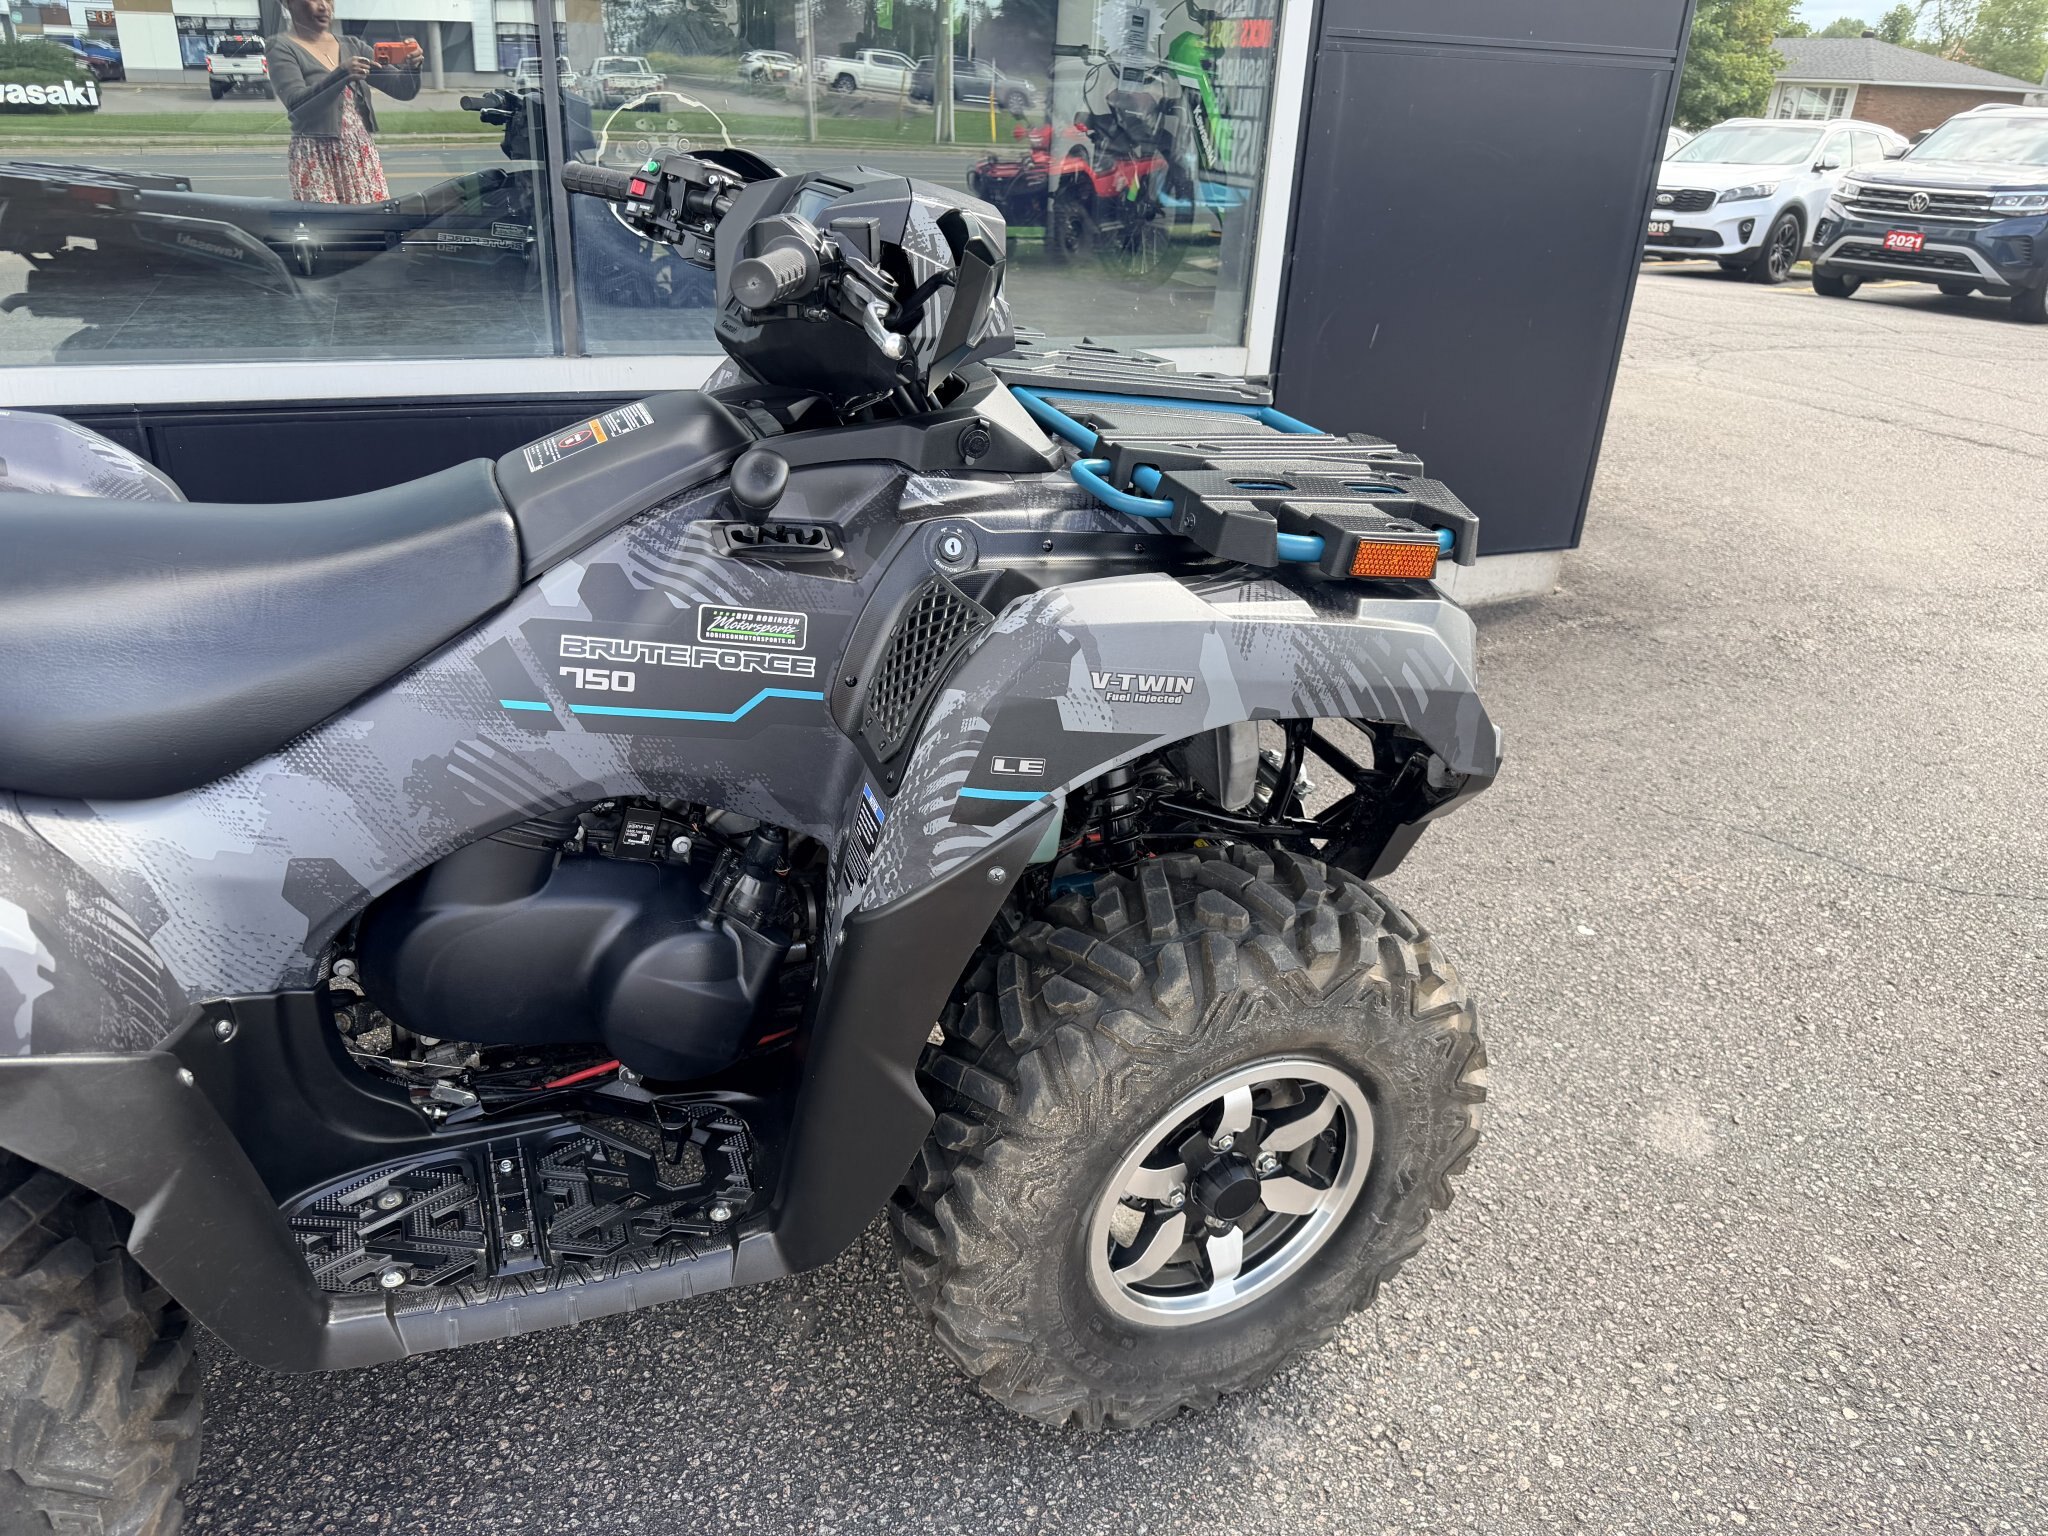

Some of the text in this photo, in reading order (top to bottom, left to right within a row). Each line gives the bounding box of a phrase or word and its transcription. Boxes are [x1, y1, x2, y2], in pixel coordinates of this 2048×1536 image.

[0, 80, 99, 106] asaki
[1886, 234, 1922, 248] 2021
[706, 615, 800, 636] Motorsports
[736, 612, 801, 625] BUD ROBINSON
[705, 631, 796, 645] ROBINSONMOTORSPORTS.CA
[560, 634, 817, 678] BRUTE FORCE
[559, 666, 636, 693] 750
[1090, 671, 1195, 694] V-TWIN
[1104, 691, 1183, 705] Fuel Injected
[993, 758, 1044, 773] LE
